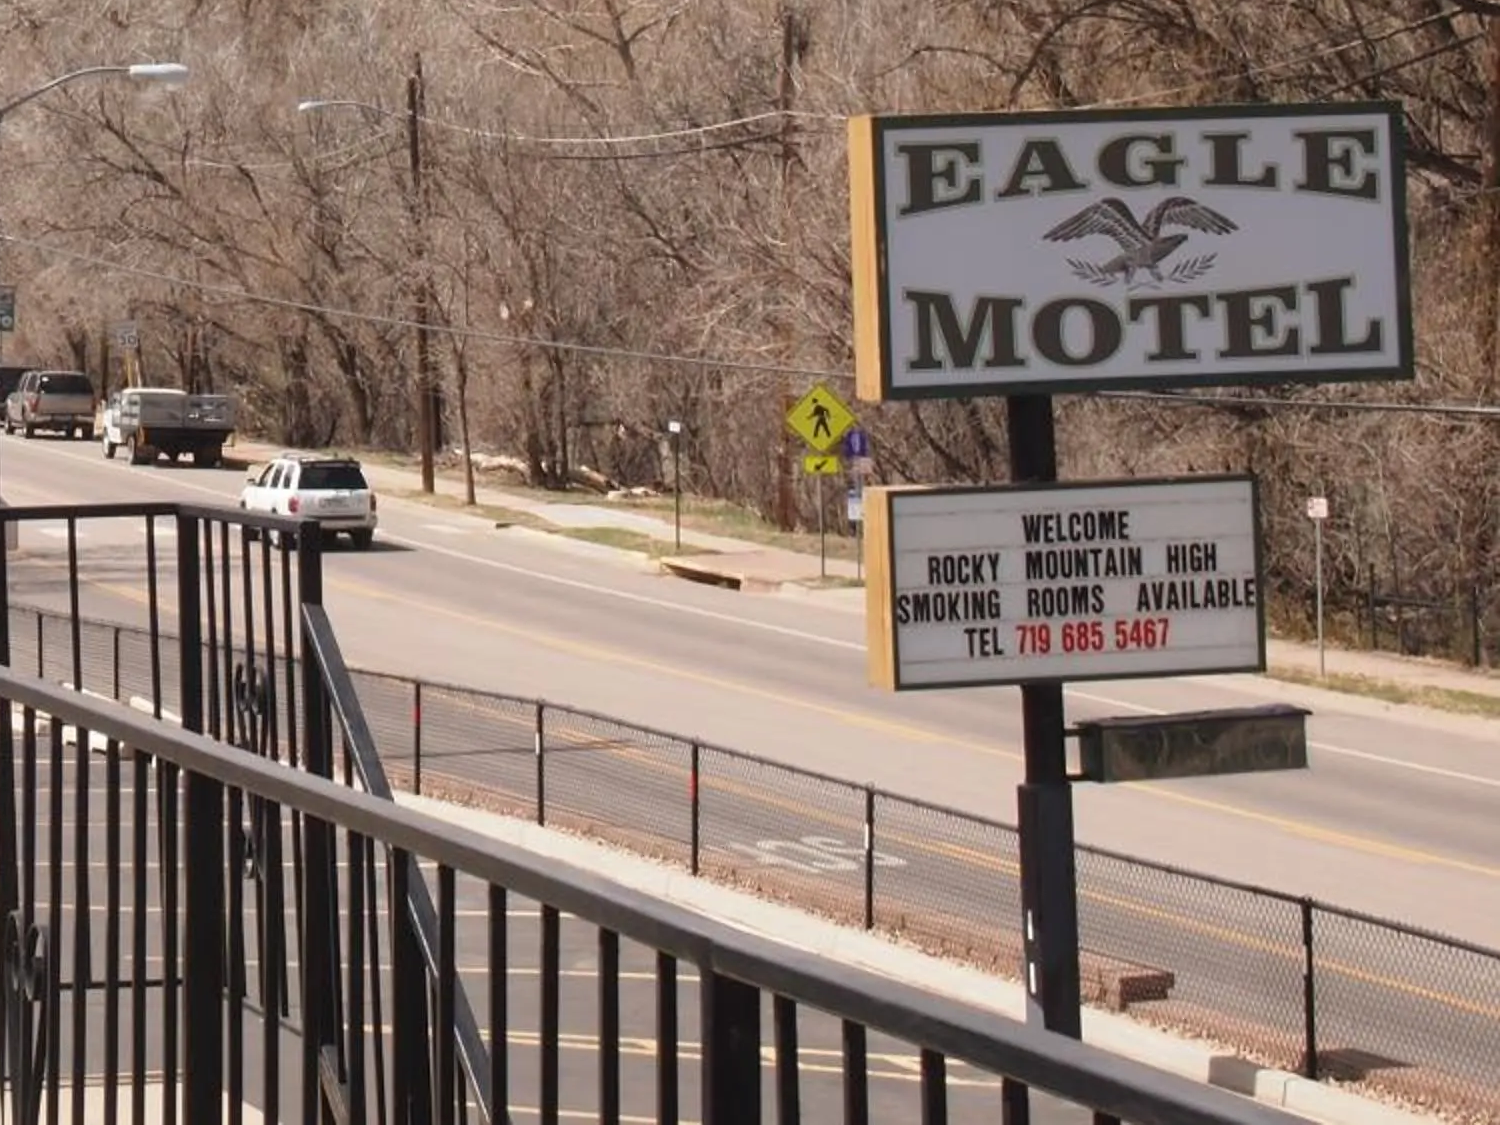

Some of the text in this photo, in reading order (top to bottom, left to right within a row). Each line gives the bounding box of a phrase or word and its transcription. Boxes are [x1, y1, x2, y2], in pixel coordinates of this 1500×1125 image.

[895, 127, 1380, 217] EAGLE
[903, 277, 1384, 371] MOTEL
[1022, 510, 1130, 544] WELCOME
[927, 543, 1218, 586] ROCKY MOUNTAIN HIGH
[897, 578, 1257, 625] SMOKING ROOMS AVAILABLE
[963, 618, 1170, 658] TEL 719 685 5467
